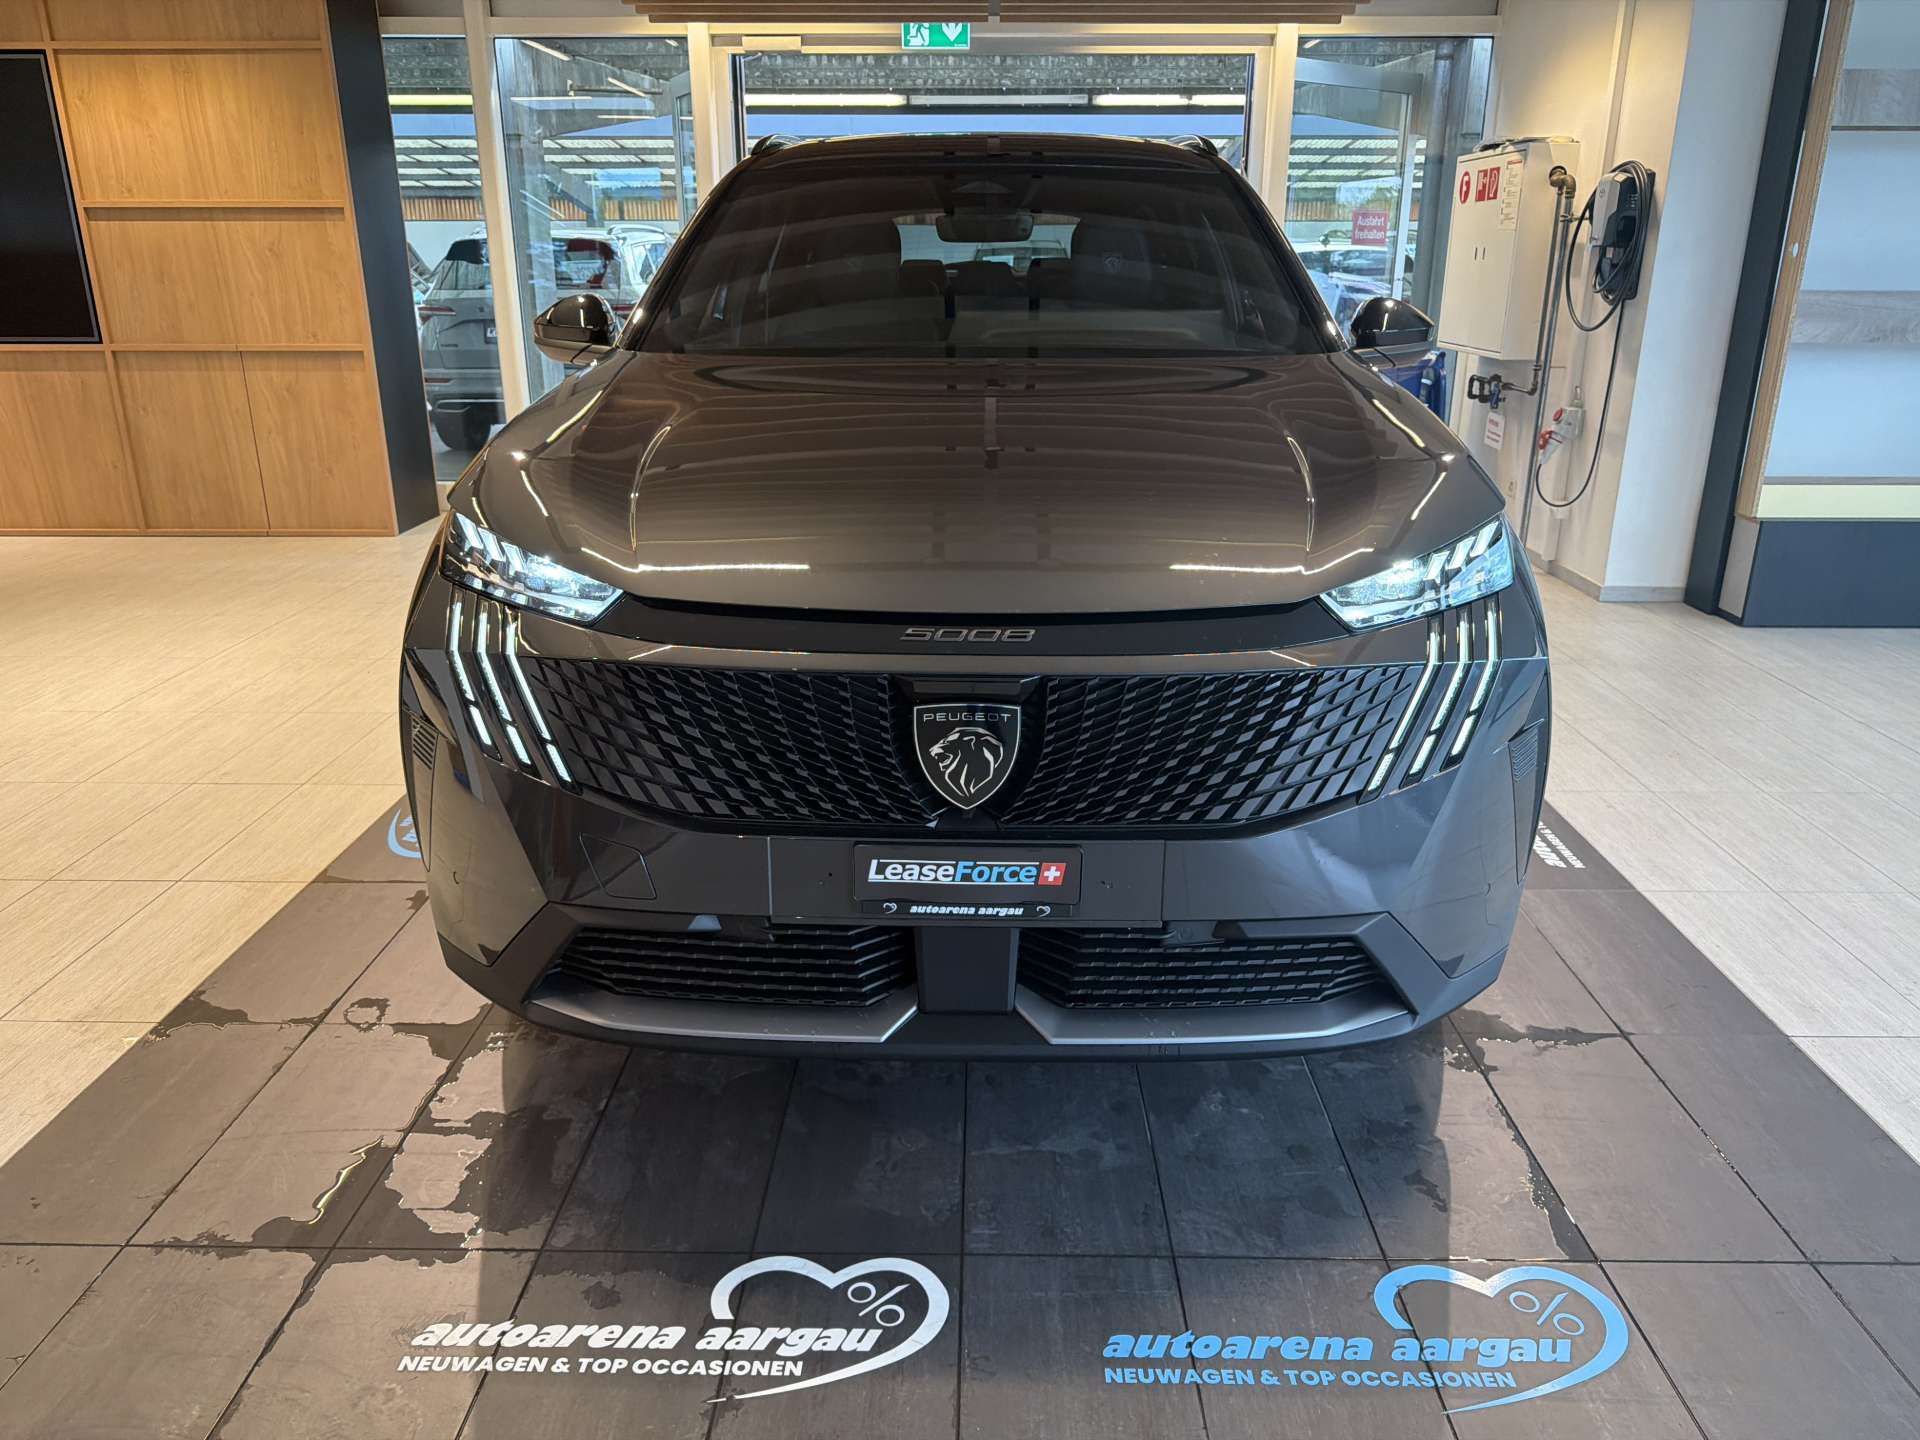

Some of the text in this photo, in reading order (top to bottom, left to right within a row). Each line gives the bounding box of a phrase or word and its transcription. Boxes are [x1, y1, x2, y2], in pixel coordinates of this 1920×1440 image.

[1357, 215, 1385, 226] Ausfahrt
[1354, 228, 1385, 240] freihalten
[900, 627, 1036, 642] 5008
[923, 712, 1011, 722] PEUGEOT
[868, 859, 1037, 883] LeaseForce
[910, 905, 1024, 917] autoarena aargau
[410, 1319, 882, 1356] autoarena aargau
[1102, 1330, 1572, 1368] autoarena aargau
[397, 1355, 803, 1377] NEUWAGEN & TOP OCCASIONEN
[1104, 1367, 1517, 1389] NEUWAGEN & TOP OCCASIONEN
